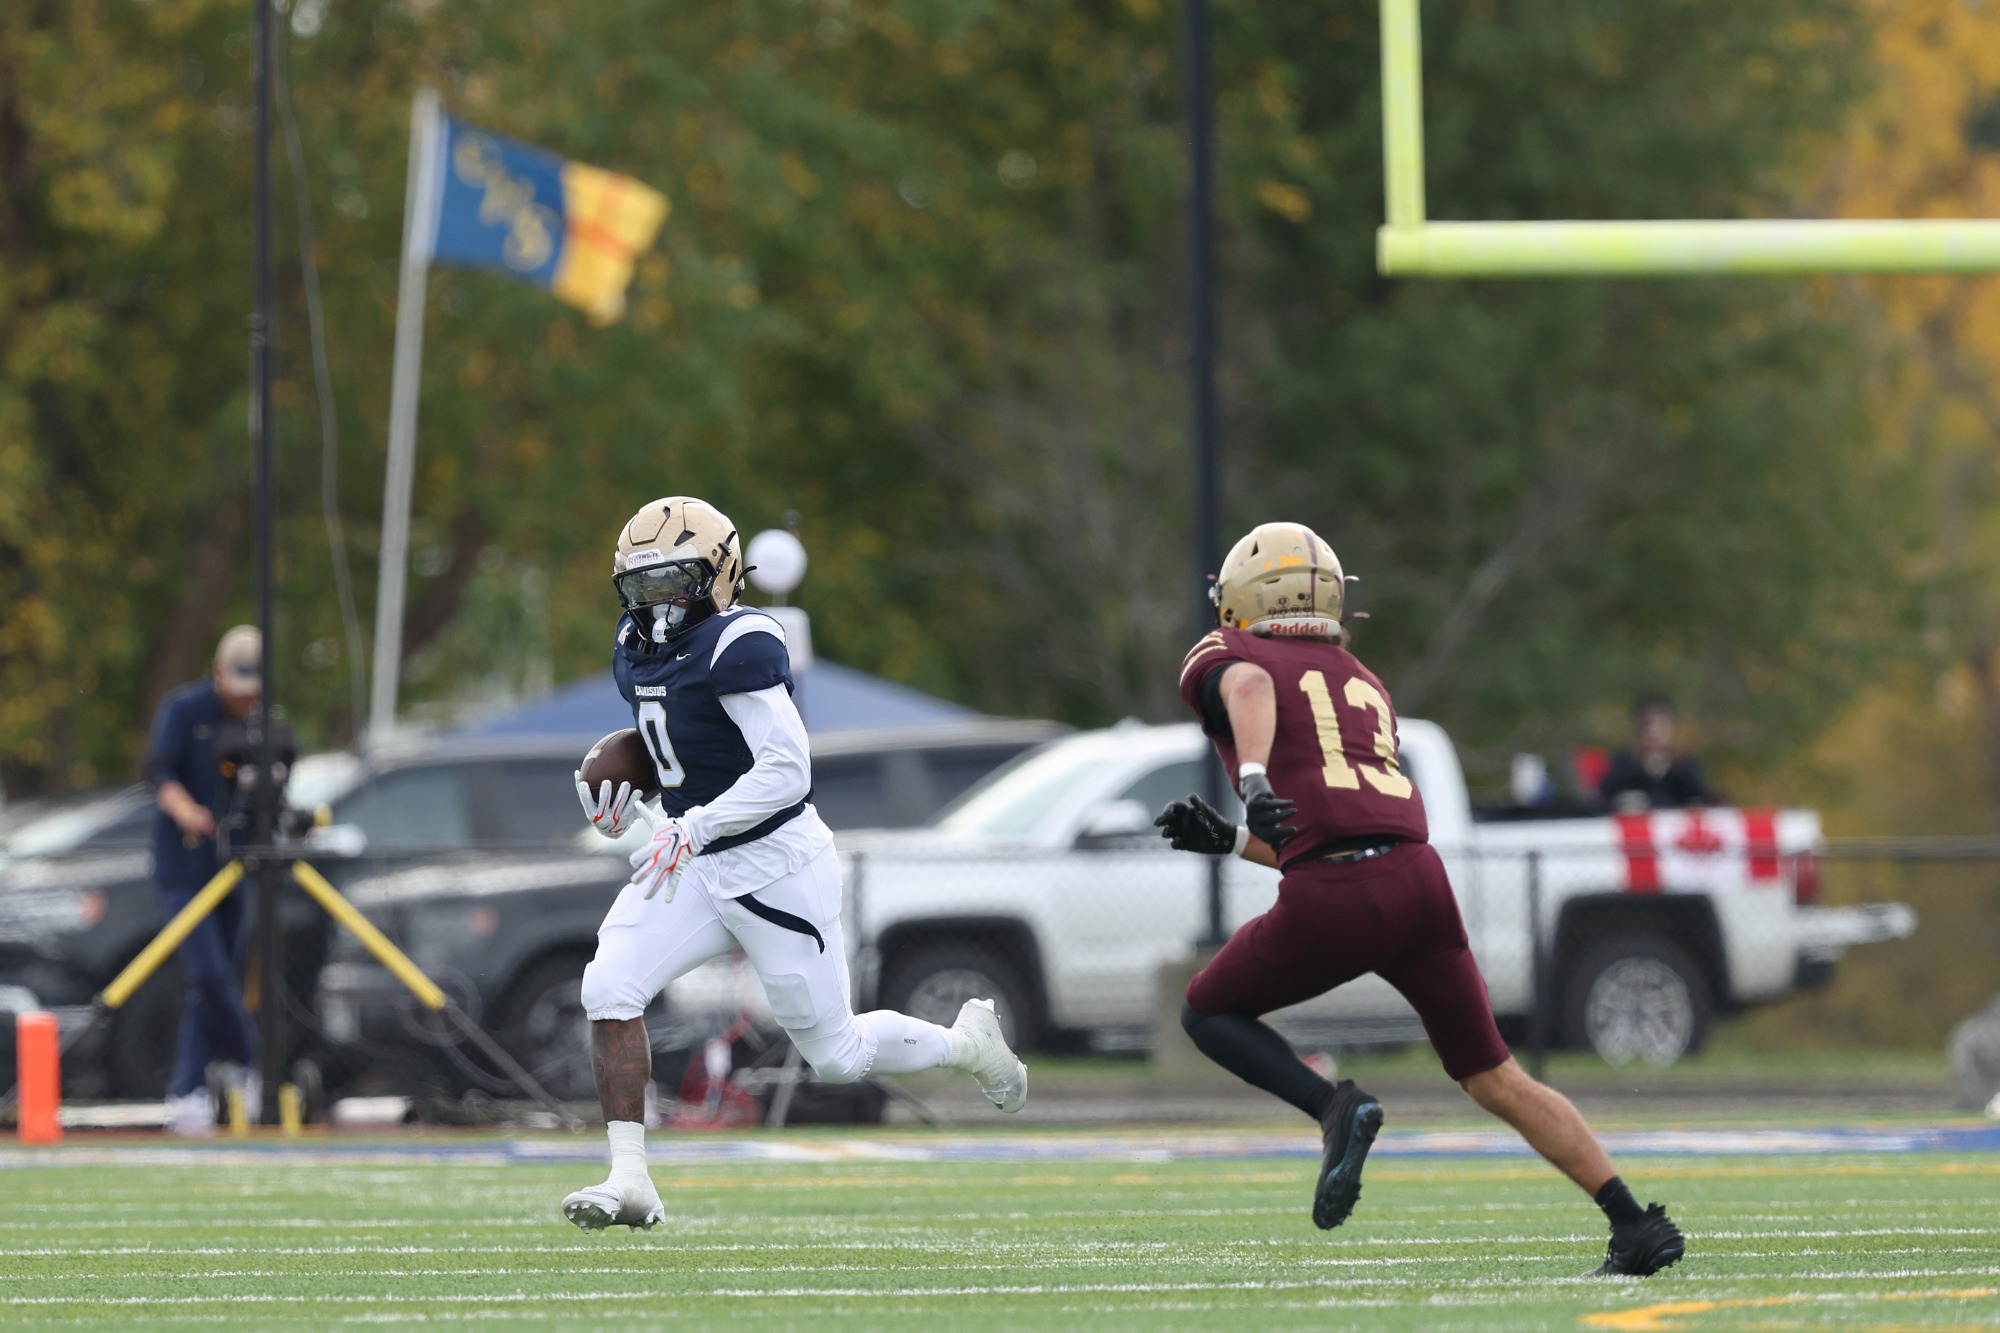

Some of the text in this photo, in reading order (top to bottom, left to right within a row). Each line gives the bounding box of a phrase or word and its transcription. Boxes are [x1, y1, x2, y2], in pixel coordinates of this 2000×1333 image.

[1269, 622, 1328, 634] Riddell
[637, 701, 686, 788] 0
[1299, 670, 1413, 799] 13
